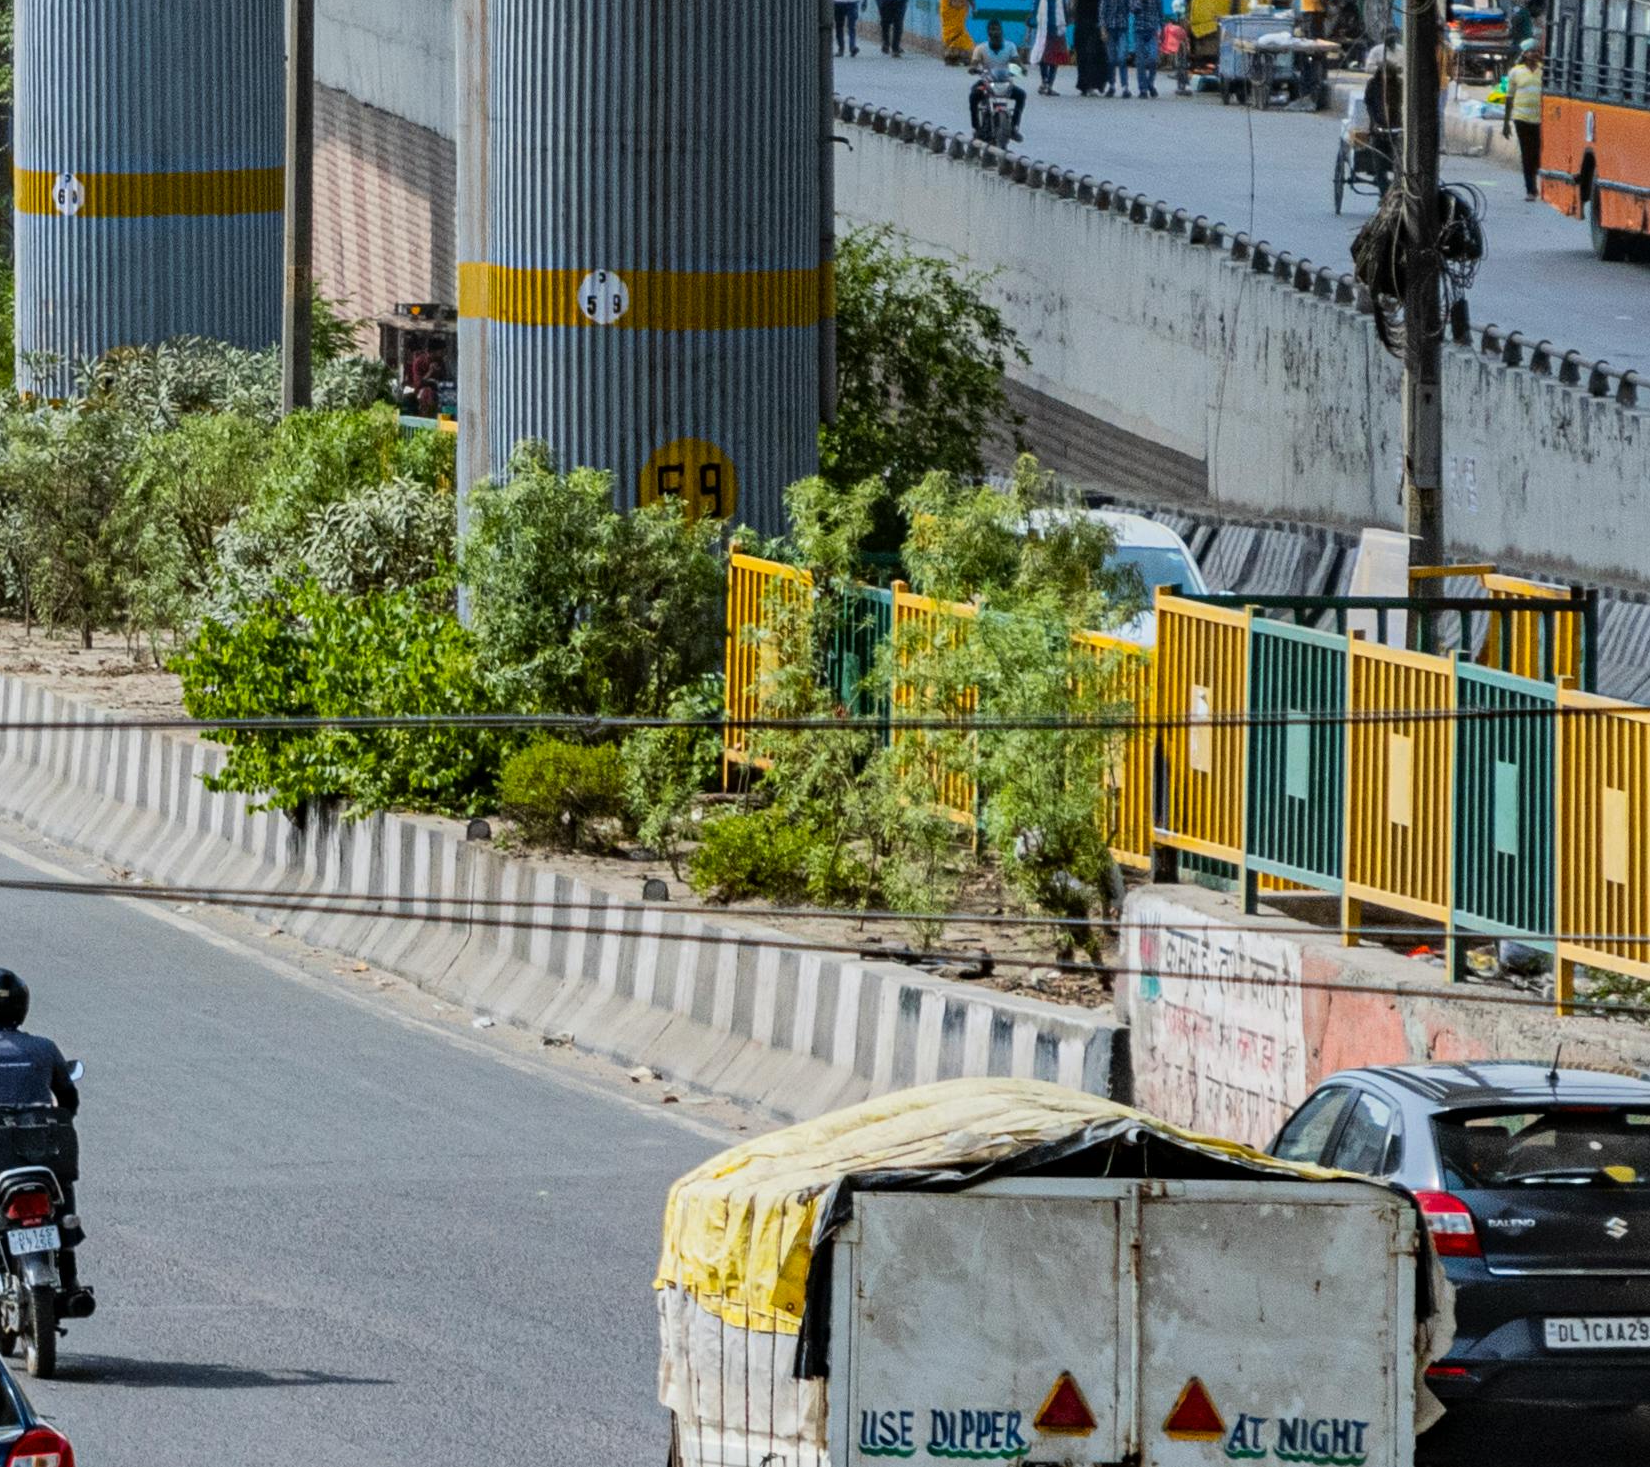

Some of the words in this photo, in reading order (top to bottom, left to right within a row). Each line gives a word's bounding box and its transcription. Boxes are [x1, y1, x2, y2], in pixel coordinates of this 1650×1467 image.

[586, 294, 622, 316] 59
[1487, 1217, 1536, 1227] BALENO
[859, 1410, 916, 1451] USE
[929, 1409, 1026, 1453] DIPPER
[1228, 1415, 1269, 1455] AT
[1275, 1417, 1367, 1460] NIGHT
